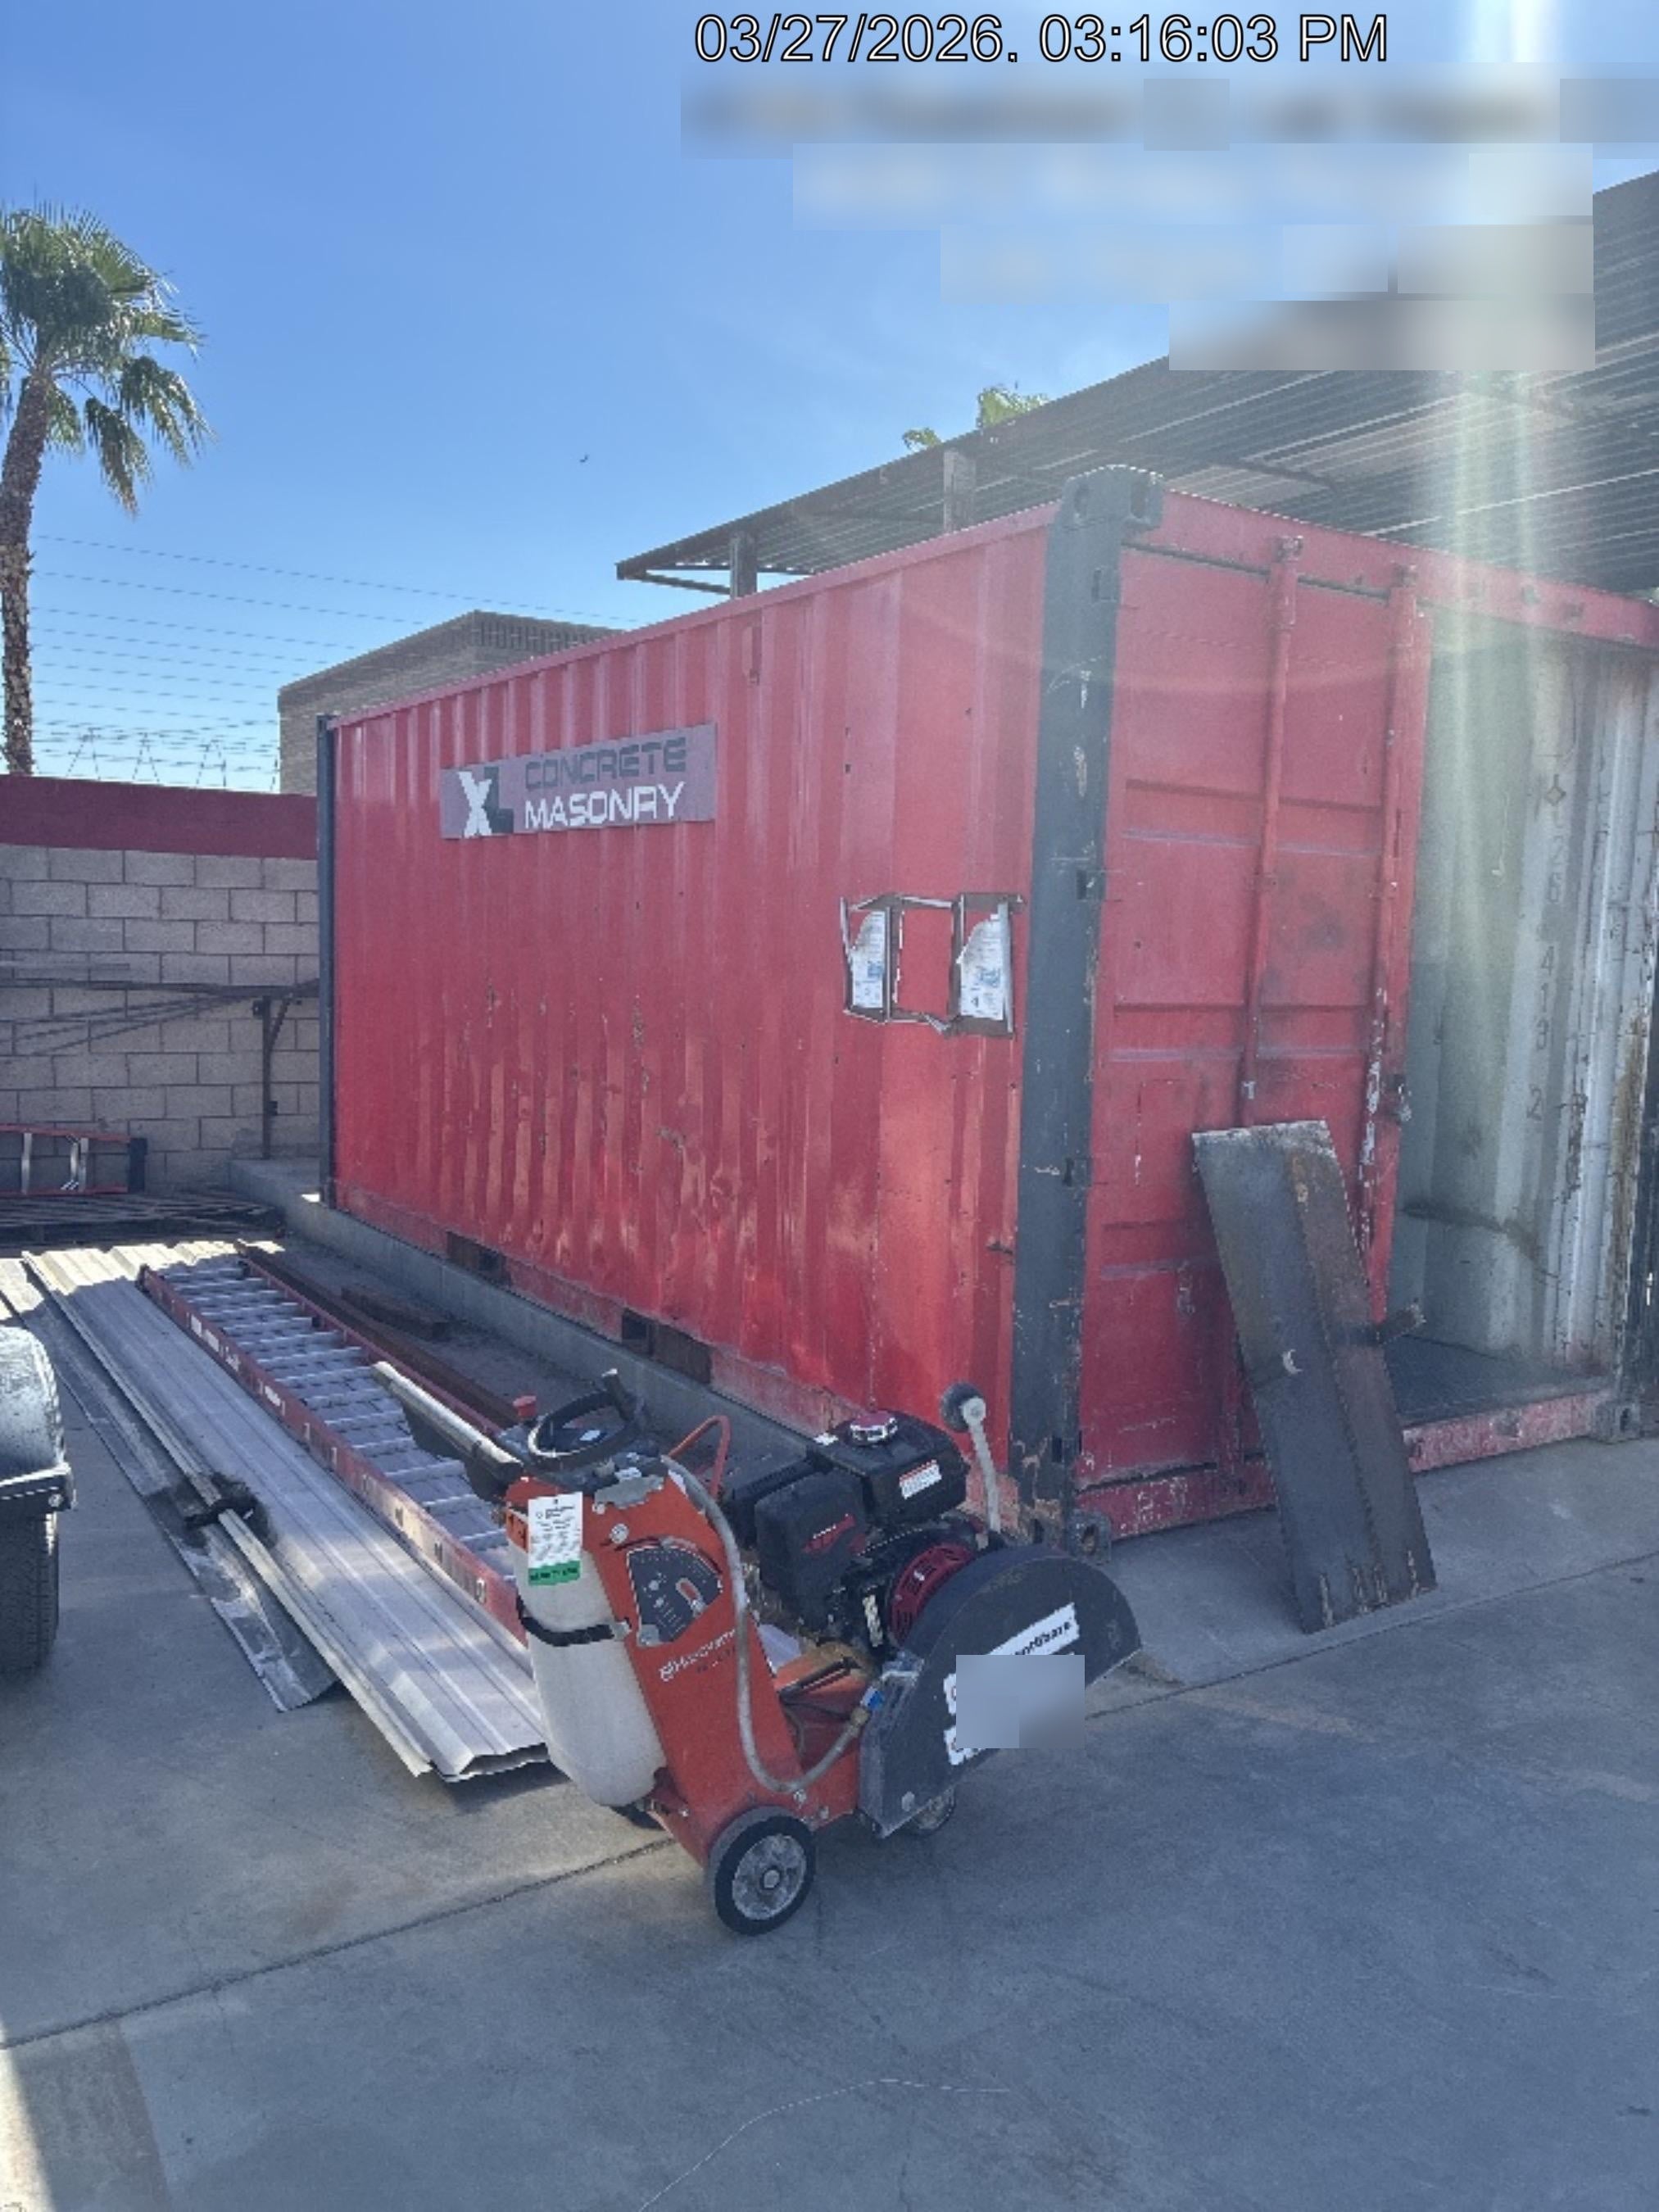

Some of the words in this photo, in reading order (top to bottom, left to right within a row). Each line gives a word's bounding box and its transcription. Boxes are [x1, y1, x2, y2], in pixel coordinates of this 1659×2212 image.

[525, 737, 687, 789] CONCRETE
[457, 766, 514, 839] XL
[525, 781, 686, 830] MASONRY
